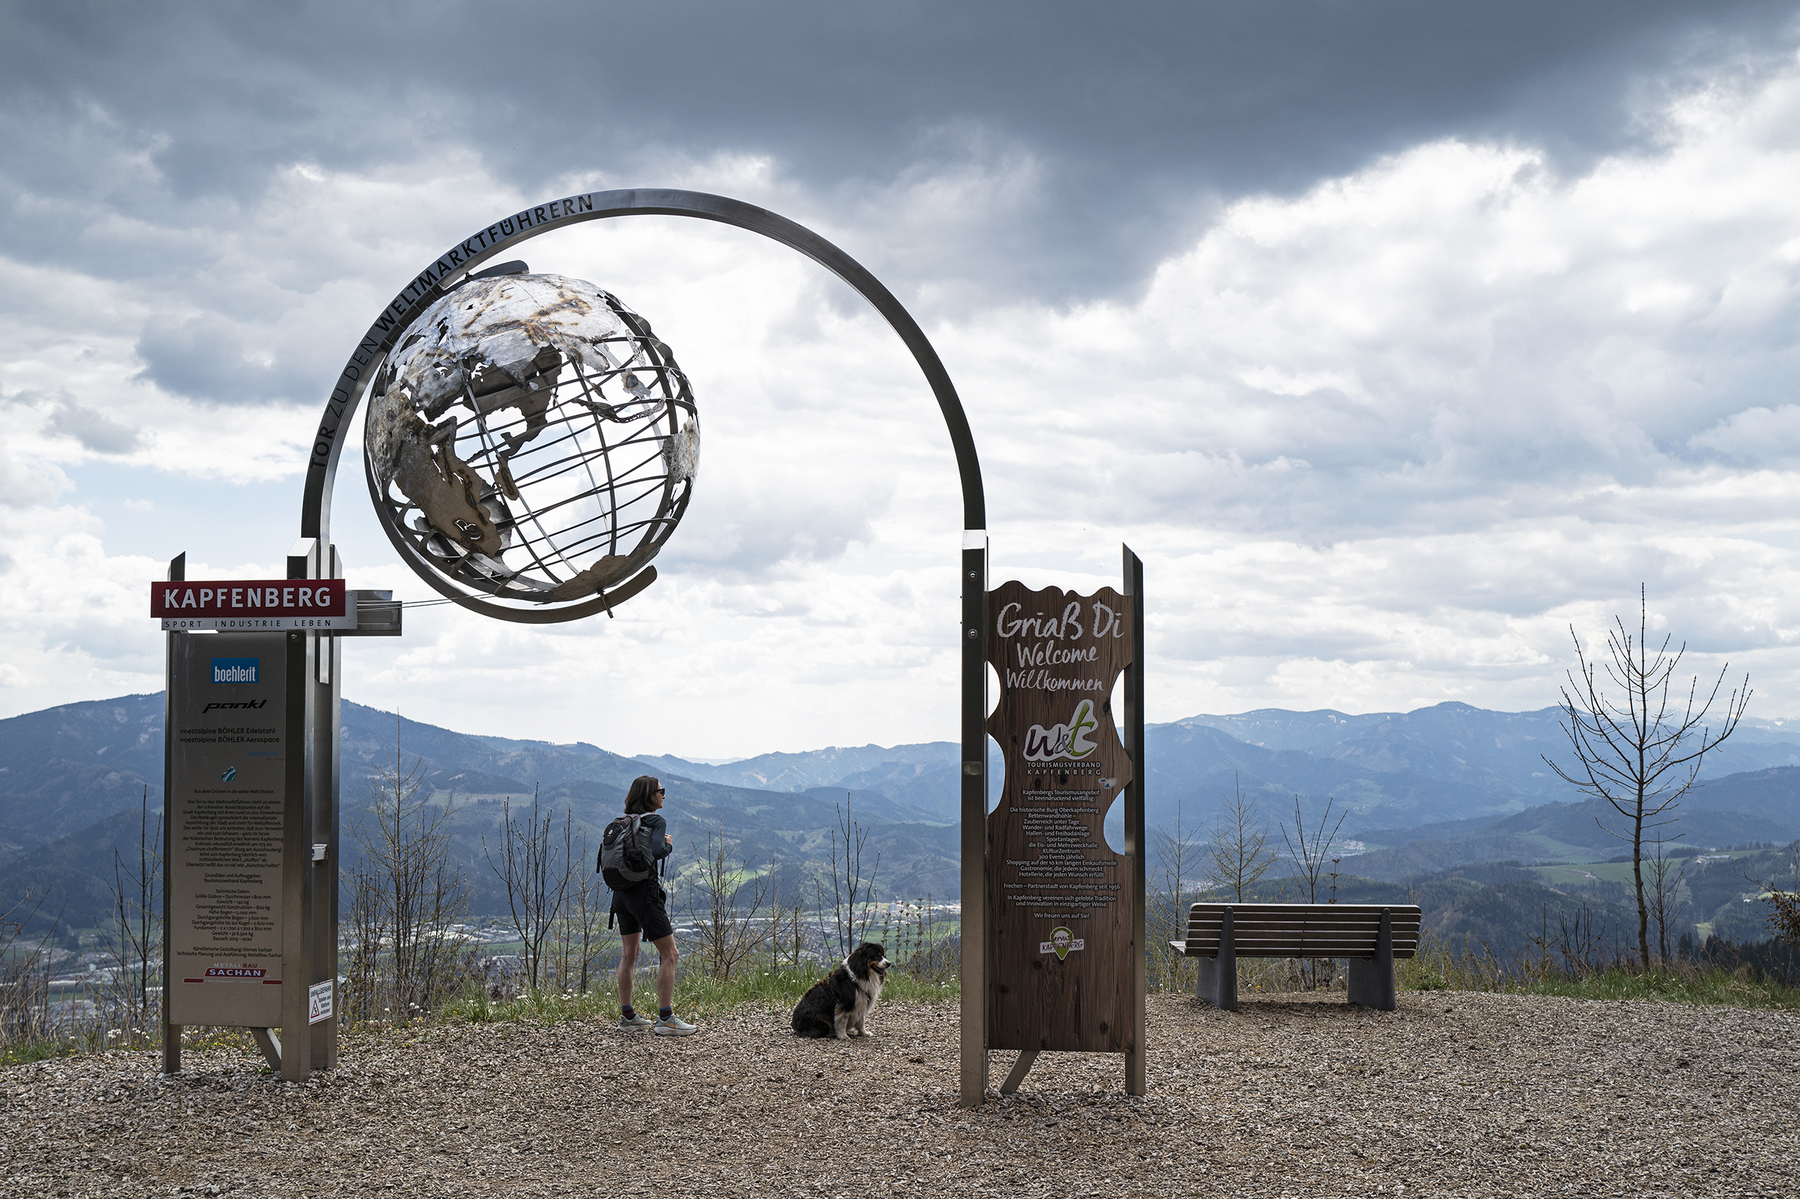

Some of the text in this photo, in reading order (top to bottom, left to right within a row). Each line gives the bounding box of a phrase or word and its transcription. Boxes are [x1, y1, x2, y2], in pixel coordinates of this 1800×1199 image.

[310, 195, 593, 469] TOR ZU DEN WELTMARKTFÜHRERN
[165, 587, 331, 609] KAPFENBERG
[165, 620, 202, 628] SPORT
[997, 601, 1125, 640] Griaß Di
[1017, 640, 1100, 668] Welcome
[214, 665, 256, 682] boehlerit
[1006, 668, 1104, 692] Willkommen
[202, 699, 268, 714] pankl
[218, 735, 245, 743] BÖHLER
